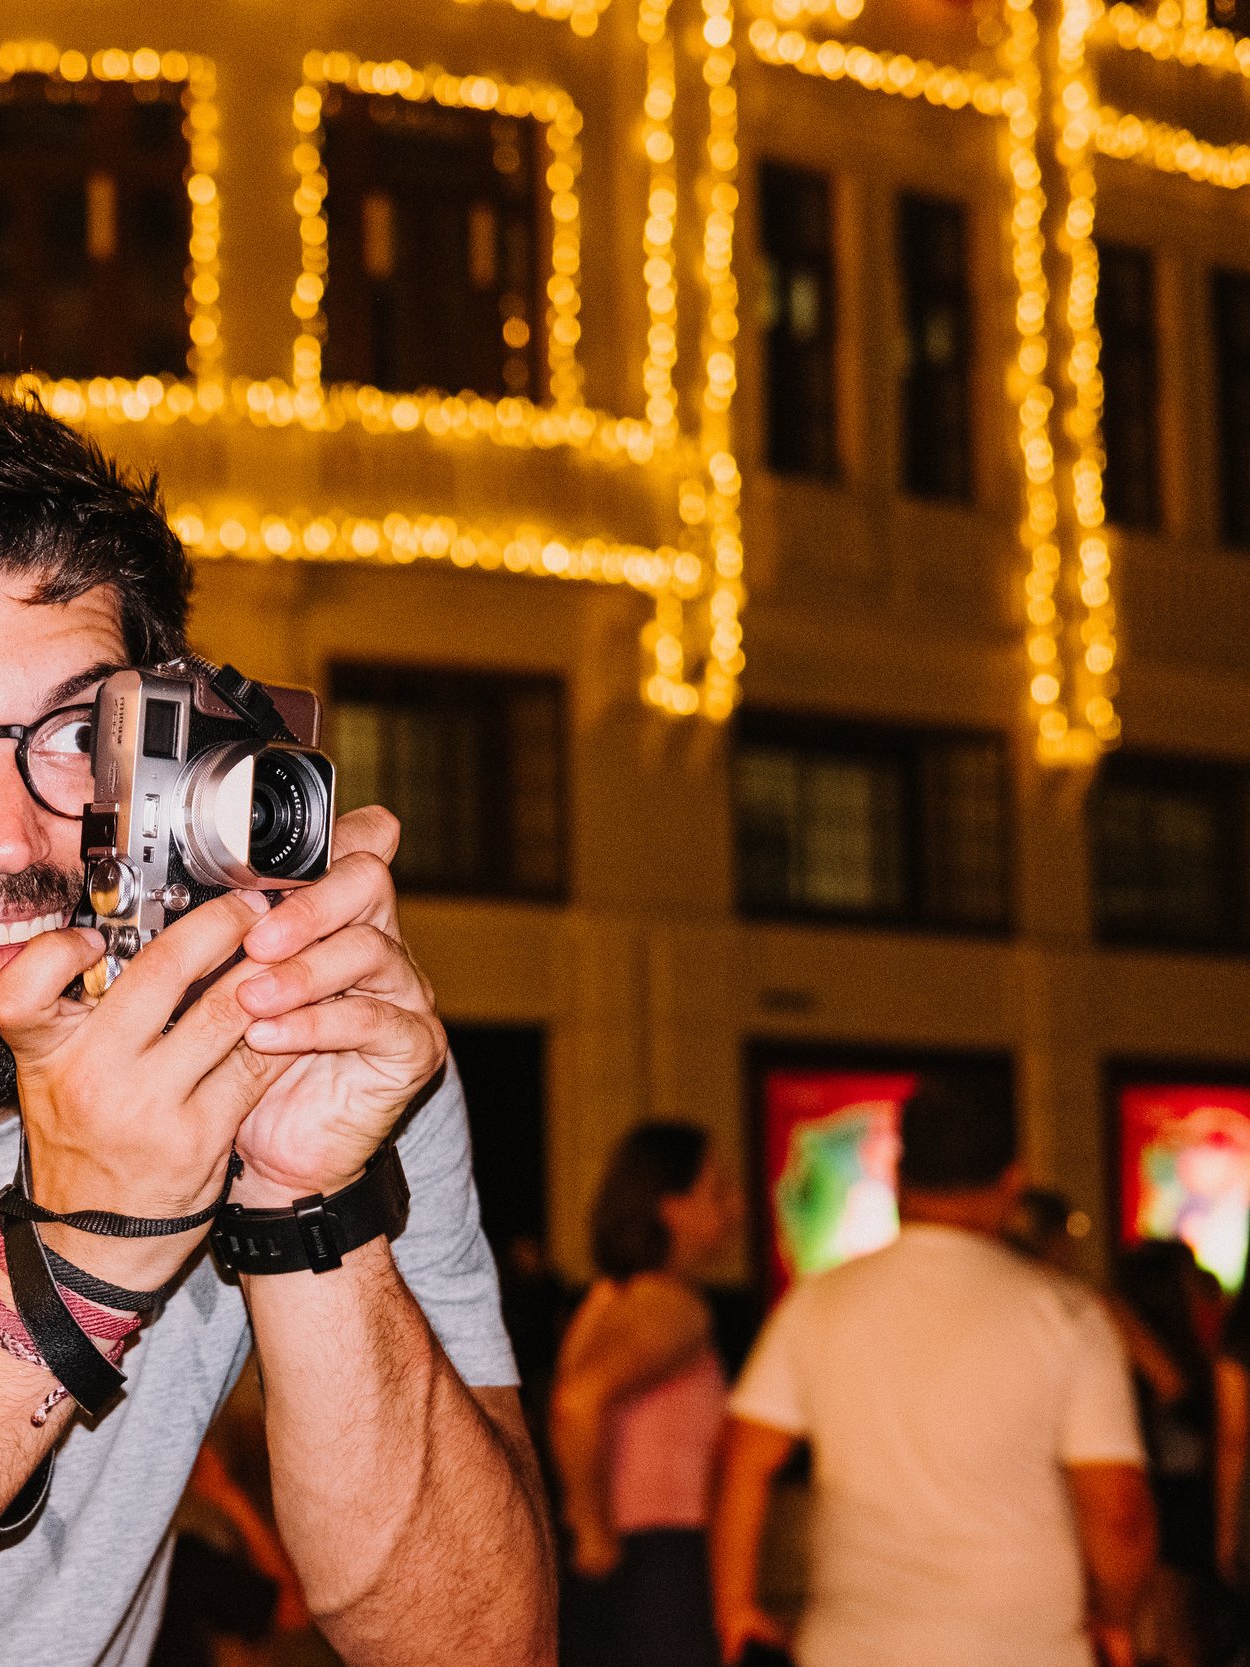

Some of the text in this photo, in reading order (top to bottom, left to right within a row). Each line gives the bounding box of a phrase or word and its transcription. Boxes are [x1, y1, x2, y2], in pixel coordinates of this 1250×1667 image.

[275, 768, 287, 780] 1:2
[290, 827, 300, 843] EBC
[271, 845, 292, 864] SUPER
